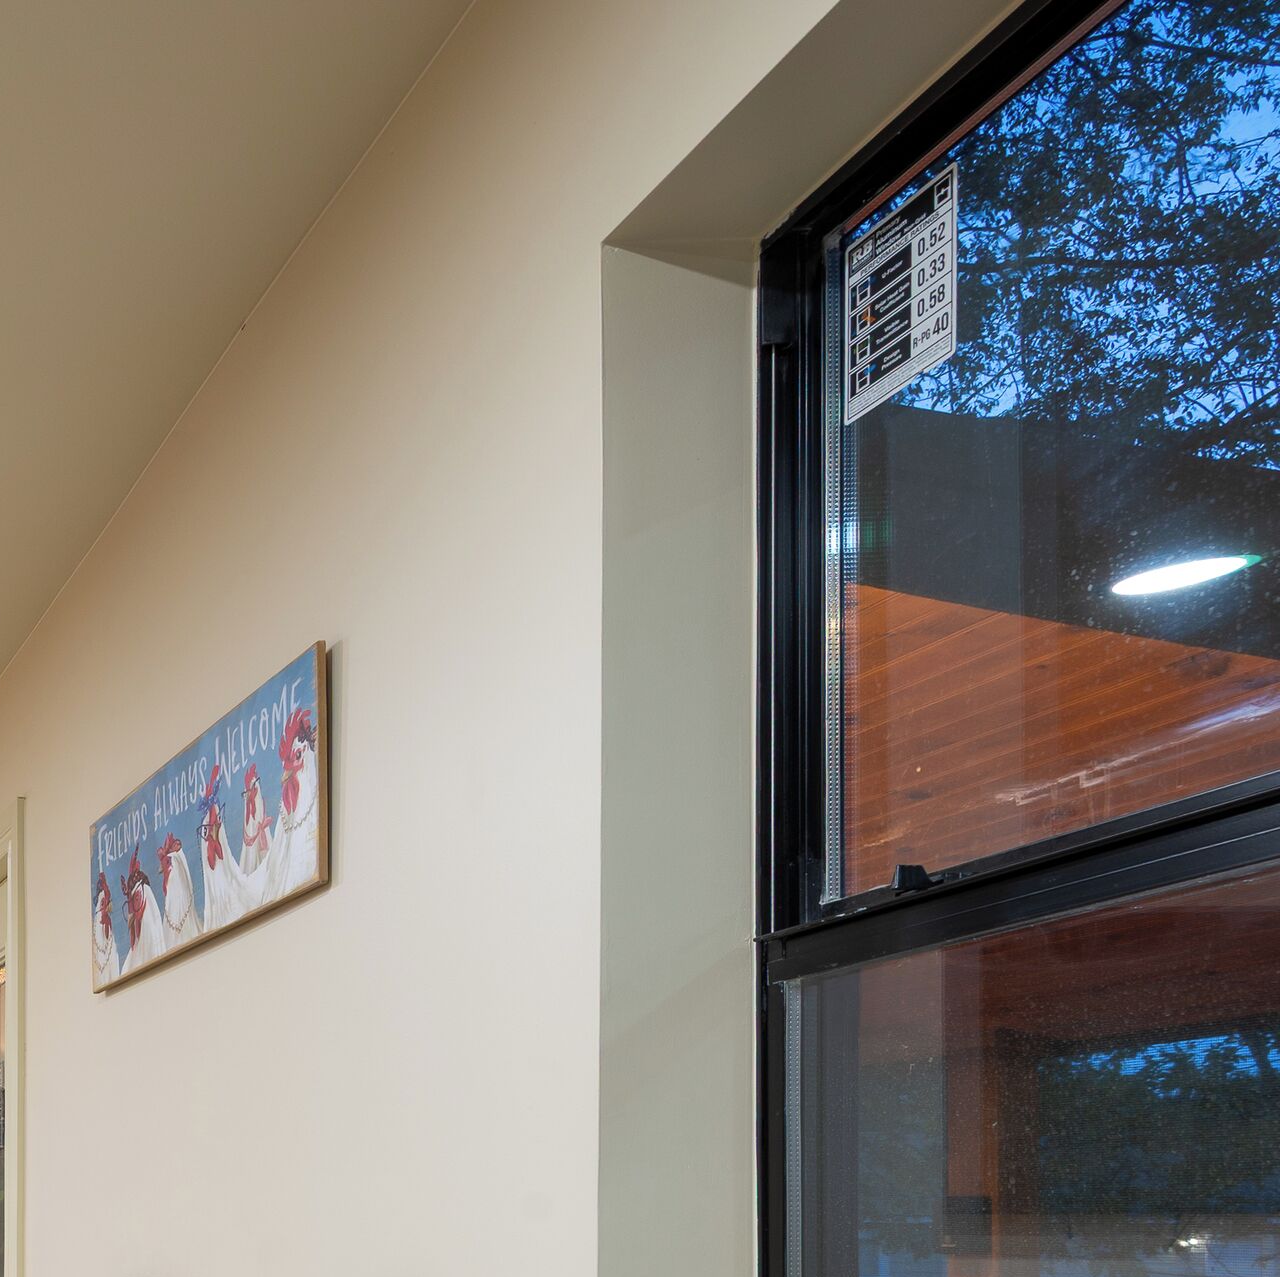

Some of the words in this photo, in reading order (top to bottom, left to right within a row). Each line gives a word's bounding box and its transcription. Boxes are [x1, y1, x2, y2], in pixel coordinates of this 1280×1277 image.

[852, 239, 872, 266] RB
[860, 235, 908, 276] PERFORMANCE
[910, 210, 939, 238] RATINGS
[917, 220, 945, 257] 0.52
[917, 251, 944, 288] 0.33
[917, 282, 944, 318] 0.58
[913, 327, 930, 349] R-PG
[932, 311, 948, 337] 40
[96, 803, 148, 868] FRIENDS
[154, 756, 208, 832] ALWAYS
[215, 676, 306, 789] WELCOME
